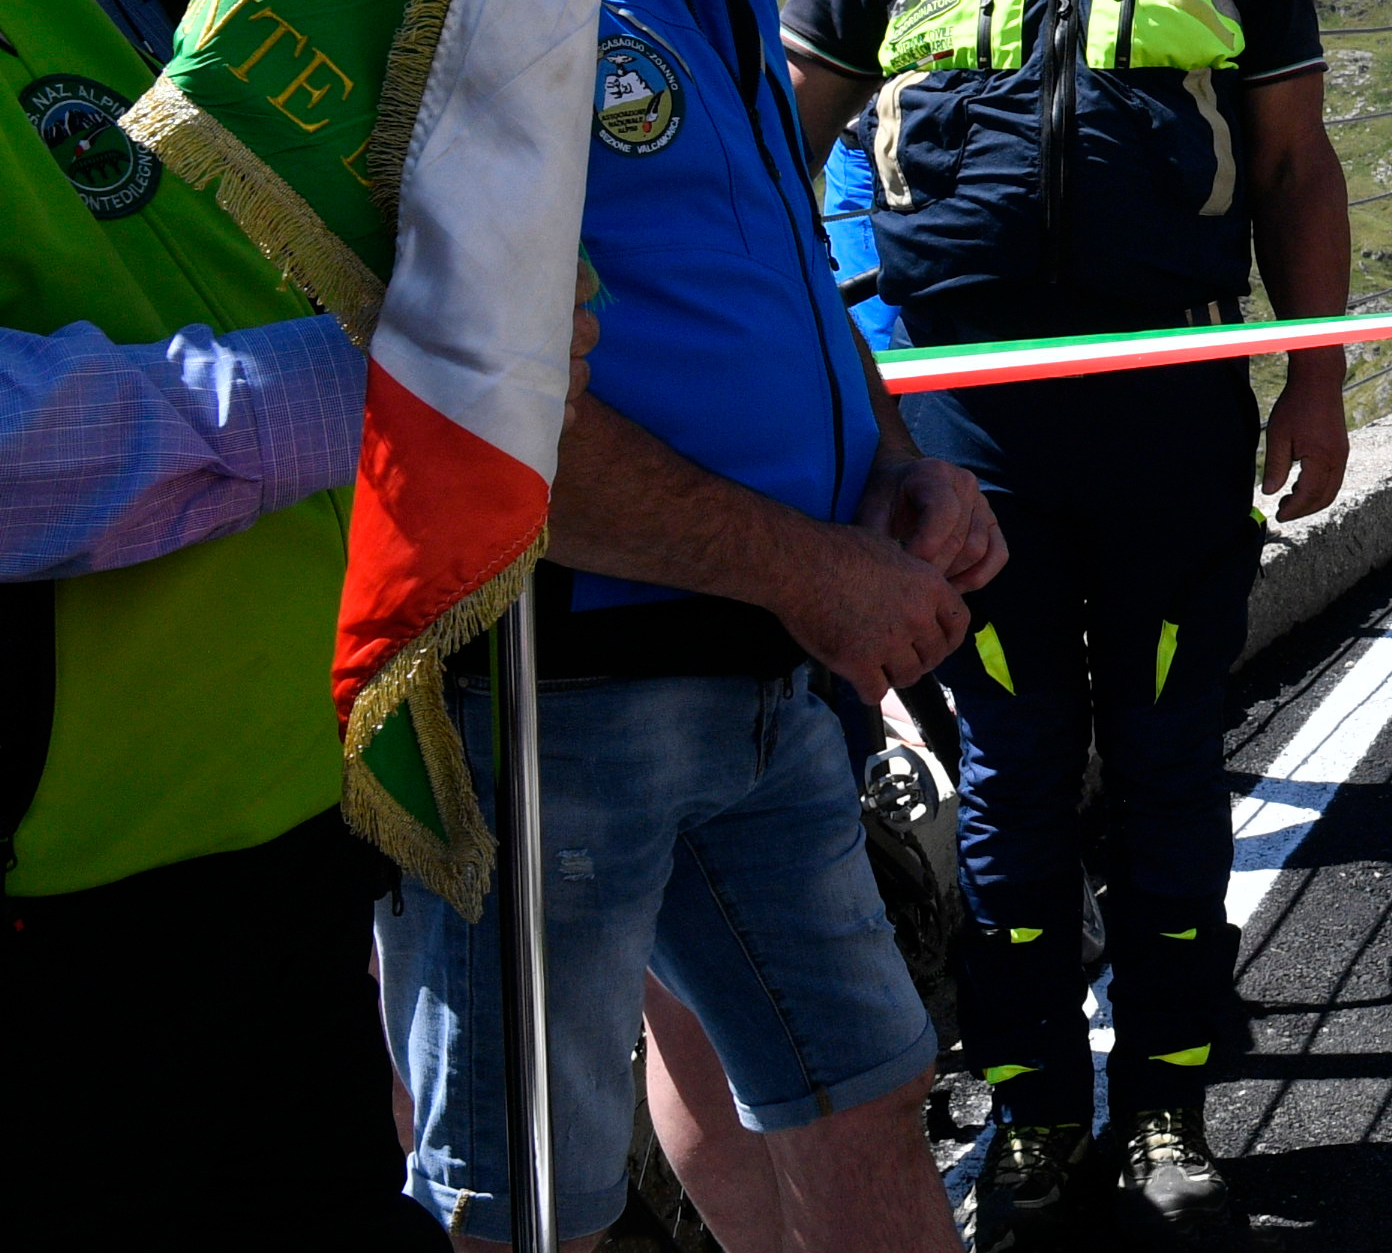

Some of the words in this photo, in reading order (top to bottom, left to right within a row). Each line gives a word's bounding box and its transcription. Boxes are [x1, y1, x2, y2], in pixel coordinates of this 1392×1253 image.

[601, 38, 645, 52] CASAGLIO
[650, 52, 678, 91] ZOANNO
[32, 83, 72, 110] NAZ
[79, 85, 128, 118] ALPIN
[599, 129, 631, 153] SEZIONE
[637, 116, 680, 154] VALCAMONICA
[79, 143, 153, 211] ONTEDILEGNO
